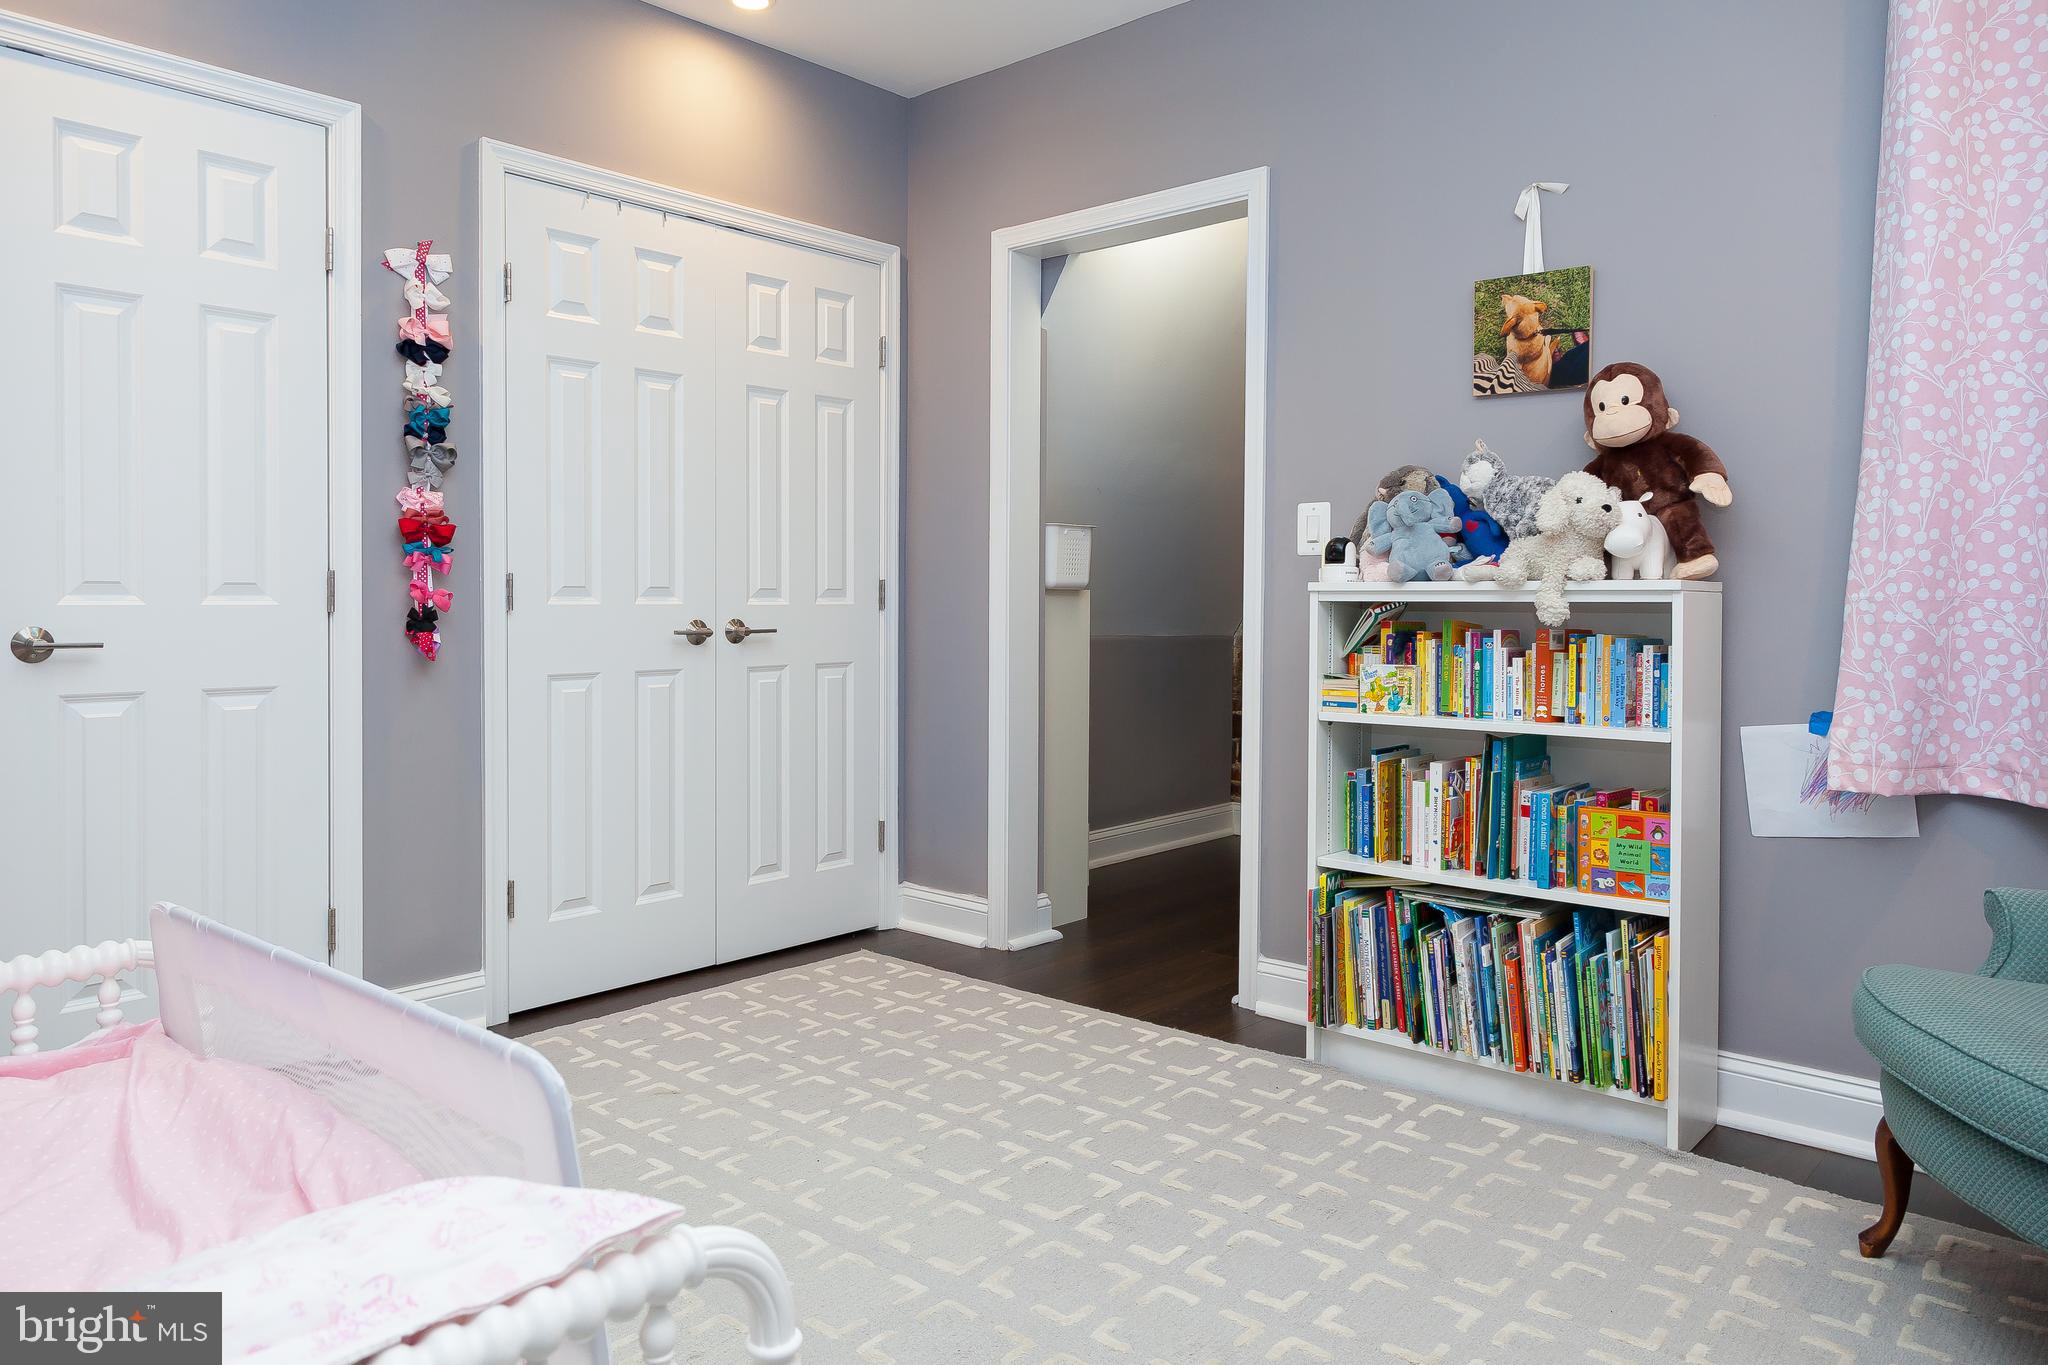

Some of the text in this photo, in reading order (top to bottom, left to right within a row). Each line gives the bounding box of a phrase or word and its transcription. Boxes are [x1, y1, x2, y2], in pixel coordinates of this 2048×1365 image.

[1432, 796, 1440, 836] RHYMOCEROS
[1540, 797, 1549, 850] Ocean Animals
[1654, 945, 1664, 971] yummy
